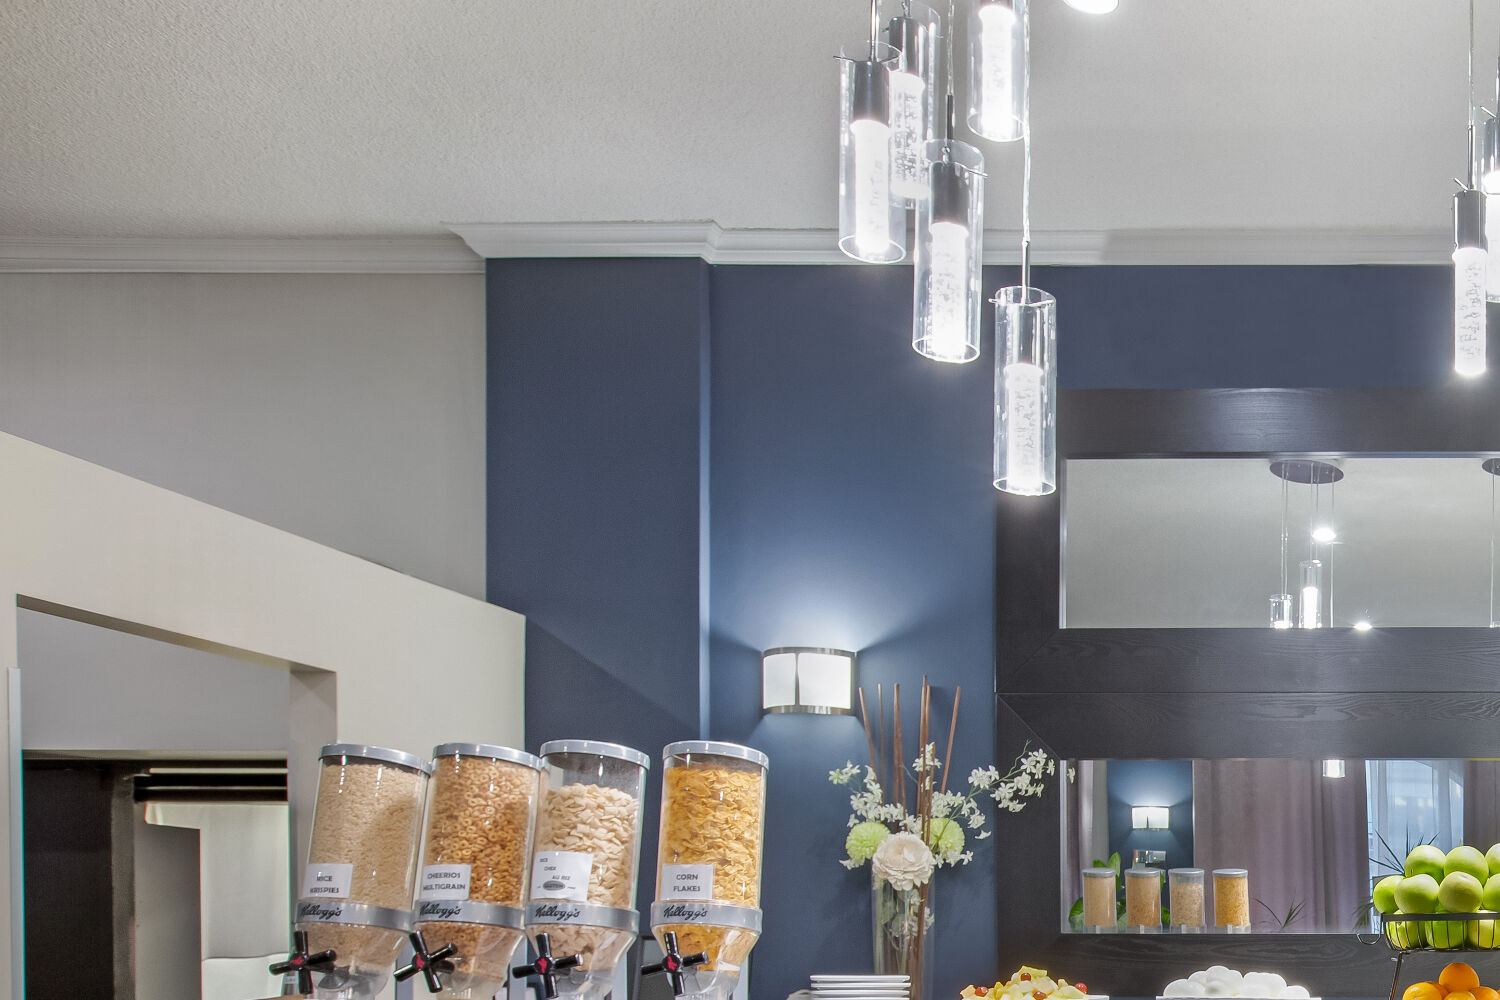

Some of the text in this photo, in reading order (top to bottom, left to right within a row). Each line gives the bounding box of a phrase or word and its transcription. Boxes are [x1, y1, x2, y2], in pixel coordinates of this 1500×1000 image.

[427, 872, 461, 880] CHEERIOS
[676, 873, 699, 881] CORN
[301, 903, 343, 920] Kellogg's
[419, 902, 462, 919] Kellogg's
[535, 904, 581, 921] Kellogg's
[663, 904, 708, 921] Kellogg's
